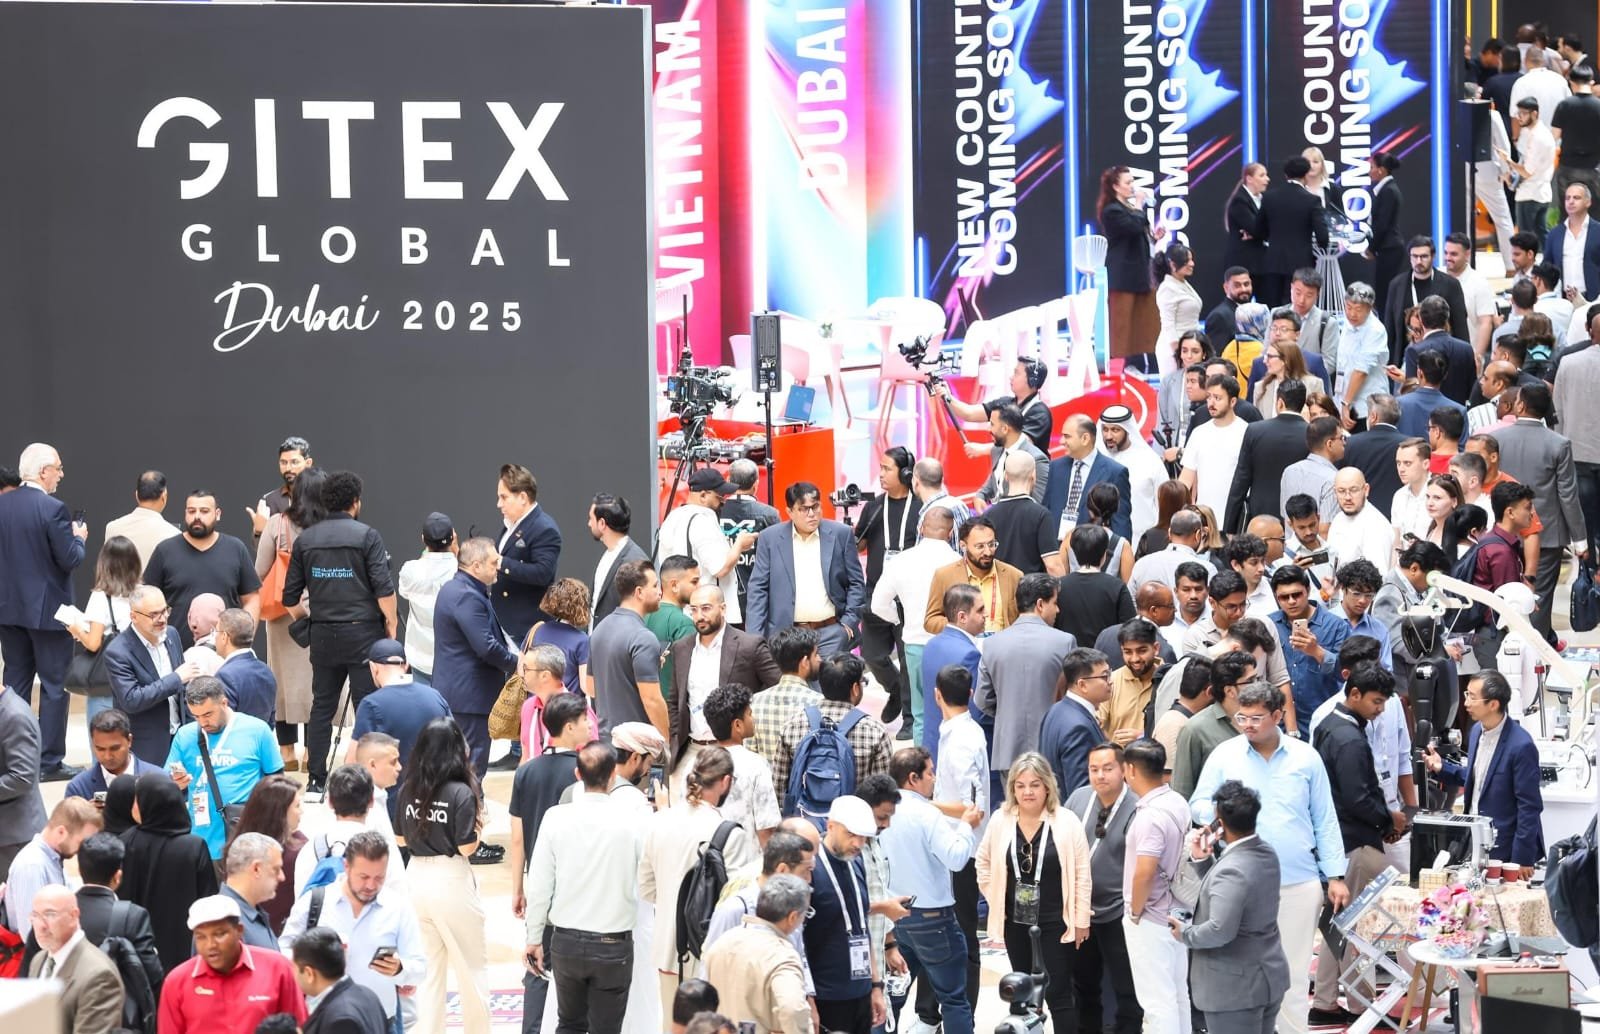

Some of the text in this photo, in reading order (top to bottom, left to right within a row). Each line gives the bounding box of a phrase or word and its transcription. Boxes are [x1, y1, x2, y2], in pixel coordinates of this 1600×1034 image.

[137, 97, 569, 201] GITEX
[655, 19, 705, 288] VIETNAM
[796, 7, 848, 190] DUBAI
[955, 0, 985, 278] NEW COUNT
[987, 88, 1018, 276] COMING
[1340, 68, 1373, 254] COMING
[181, 223, 570, 267] GLOBAL
[213, 281, 522, 353] Dubai 2025
